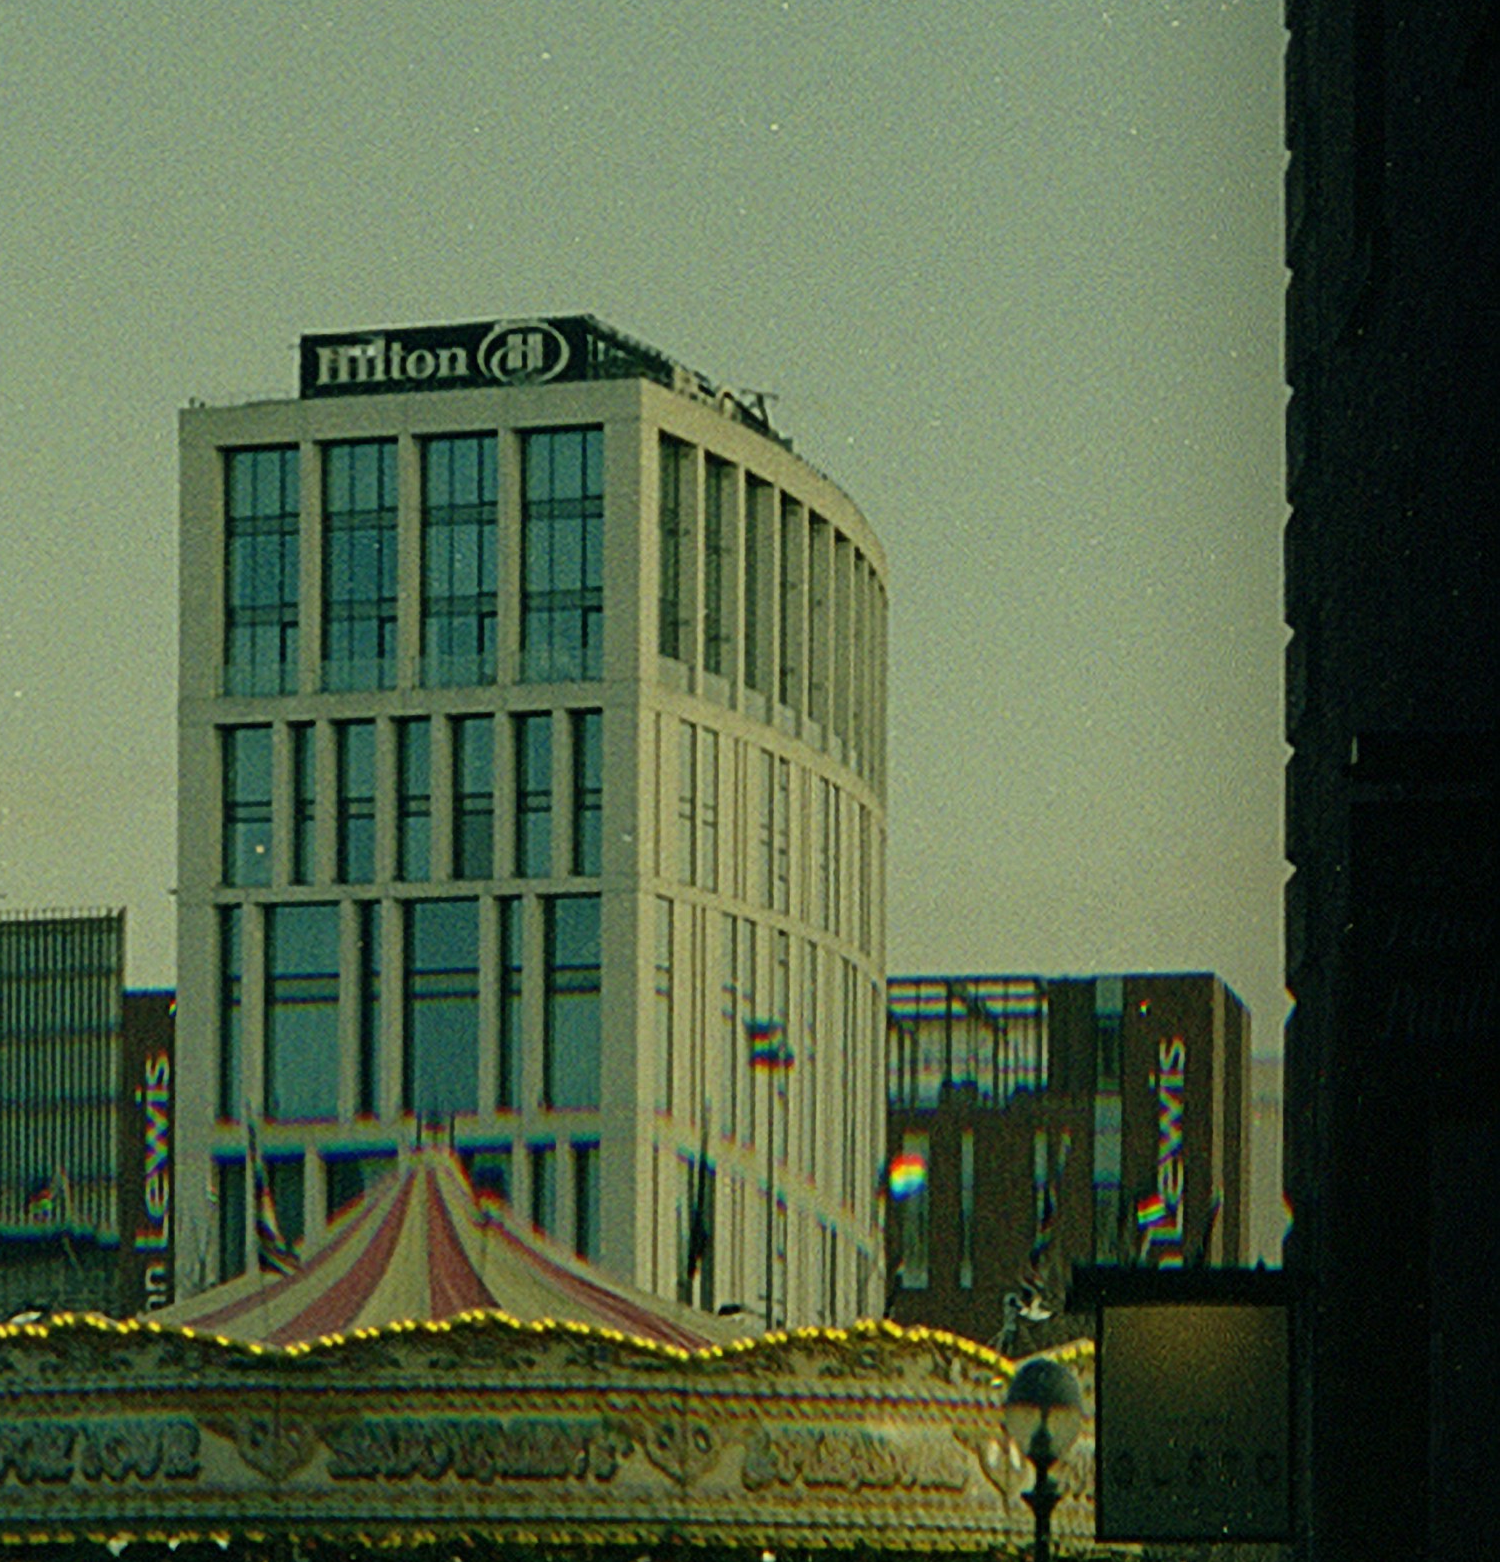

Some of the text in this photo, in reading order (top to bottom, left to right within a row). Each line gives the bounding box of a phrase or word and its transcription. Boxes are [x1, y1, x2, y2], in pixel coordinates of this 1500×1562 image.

[315, 338, 469, 385] Hilton
[134, 1051, 171, 1253] Lewis
[1148, 1035, 1186, 1245] Lewis
